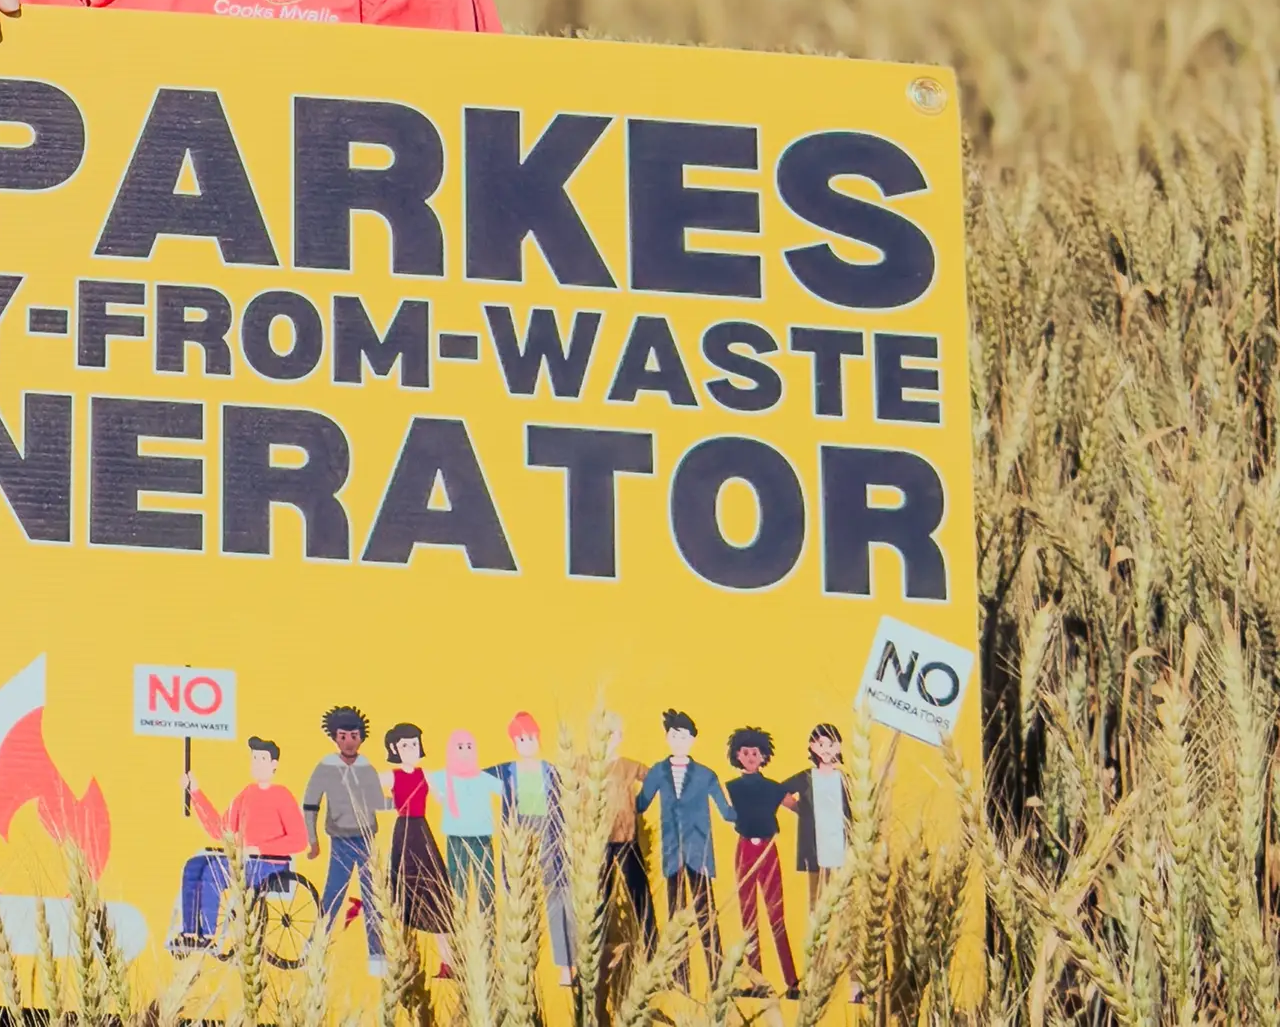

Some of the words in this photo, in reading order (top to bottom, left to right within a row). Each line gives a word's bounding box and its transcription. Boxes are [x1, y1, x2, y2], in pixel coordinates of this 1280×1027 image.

[148, 673, 223, 716] NO
[875, 638, 960, 707] NO
[140, 718, 172, 728] ENERGY
[174, 720, 199, 729] FROM
[200, 722, 229, 731] WASTE
[864, 684, 951, 731] INCINERATORS
